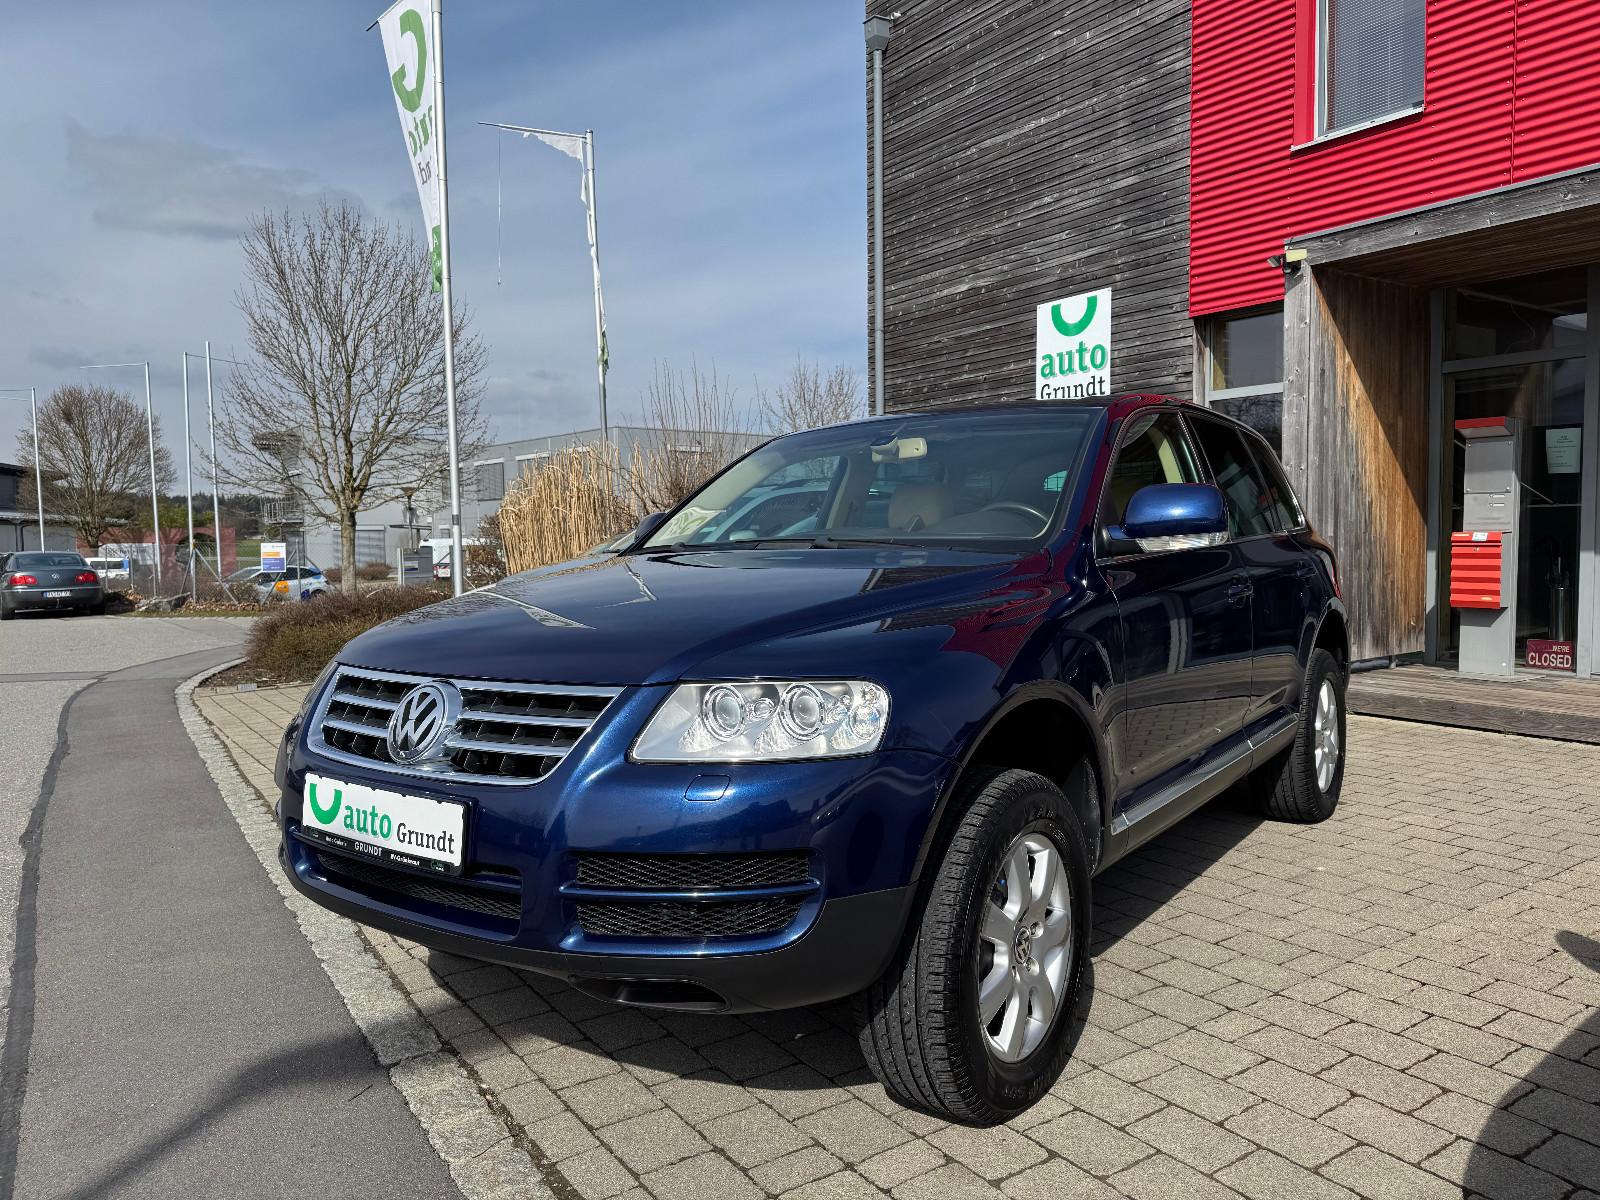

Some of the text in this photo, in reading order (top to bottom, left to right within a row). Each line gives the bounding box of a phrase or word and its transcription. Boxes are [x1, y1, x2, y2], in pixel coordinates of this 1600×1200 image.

[1040, 340, 1107, 379] auto
[1040, 376, 1105, 399] Grundt
[1528, 652, 1571, 667] CLOSED
[343, 805, 455, 854] auto Grundt
[354, 842, 383, 857] GRUNDT
